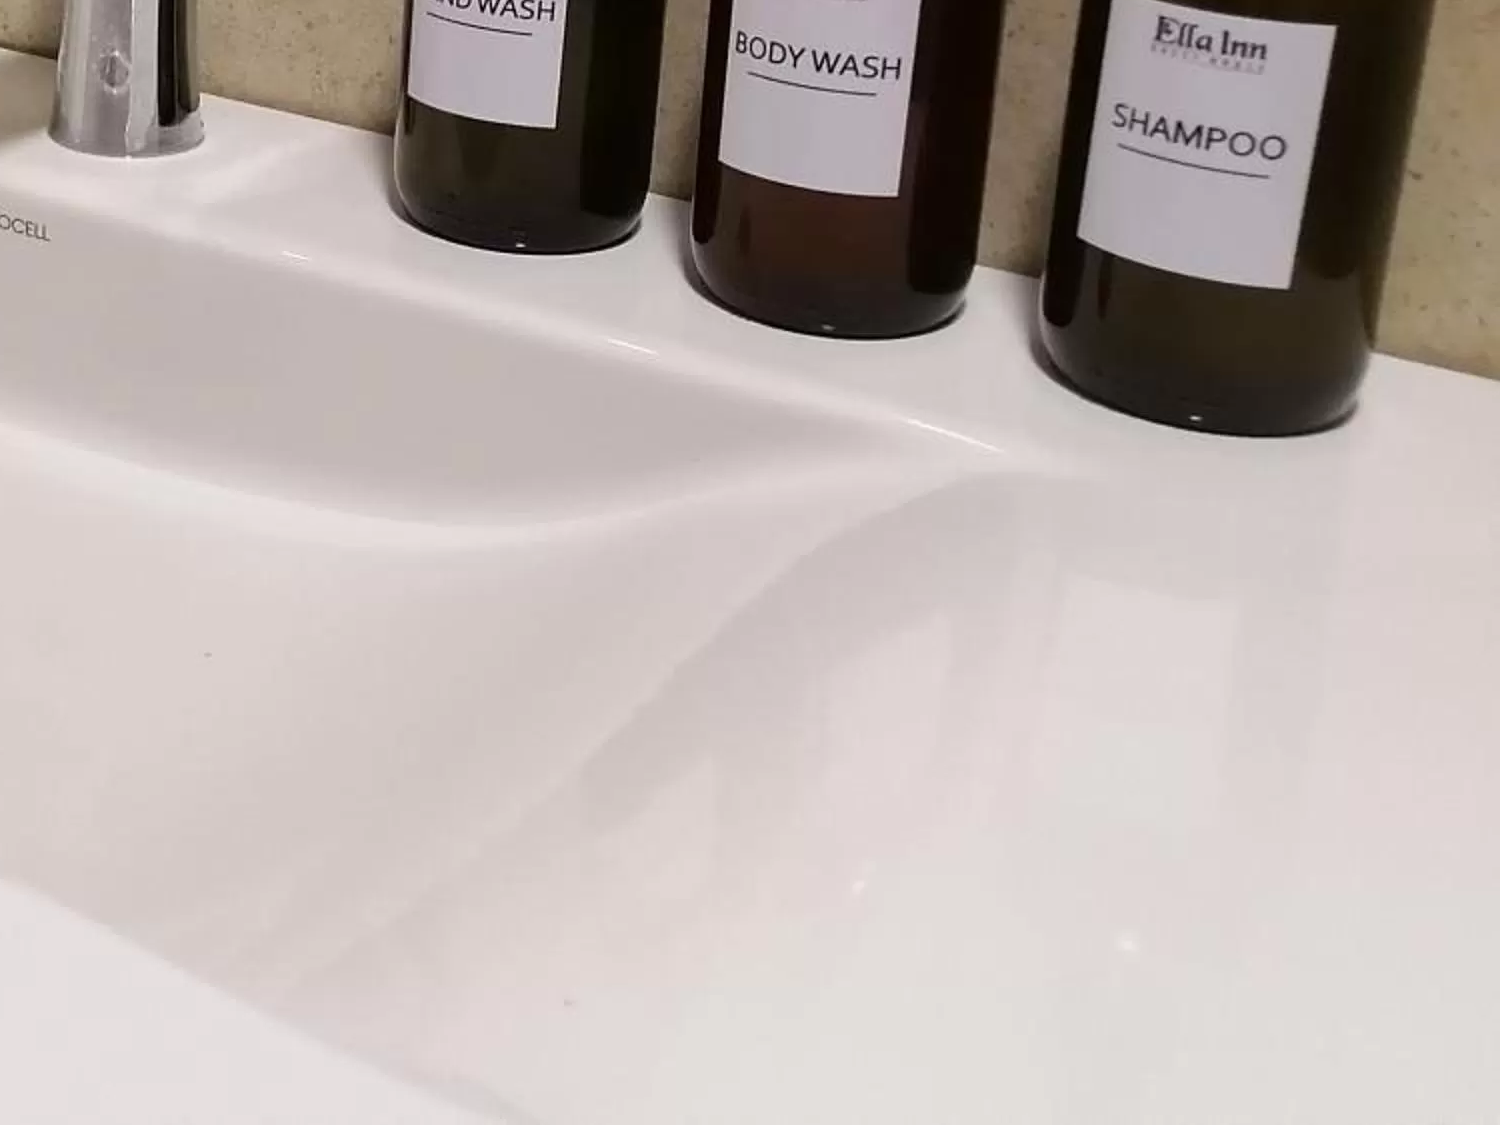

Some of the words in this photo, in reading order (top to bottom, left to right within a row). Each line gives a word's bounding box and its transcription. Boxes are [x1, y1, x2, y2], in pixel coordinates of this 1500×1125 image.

[735, 30, 806, 70] BODY
[811, 48, 901, 81] WASH
[1154, 15, 1213, 52] Ella
[1220, 29, 1268, 60] Inn
[1111, 102, 1288, 161] SHAMPOO
